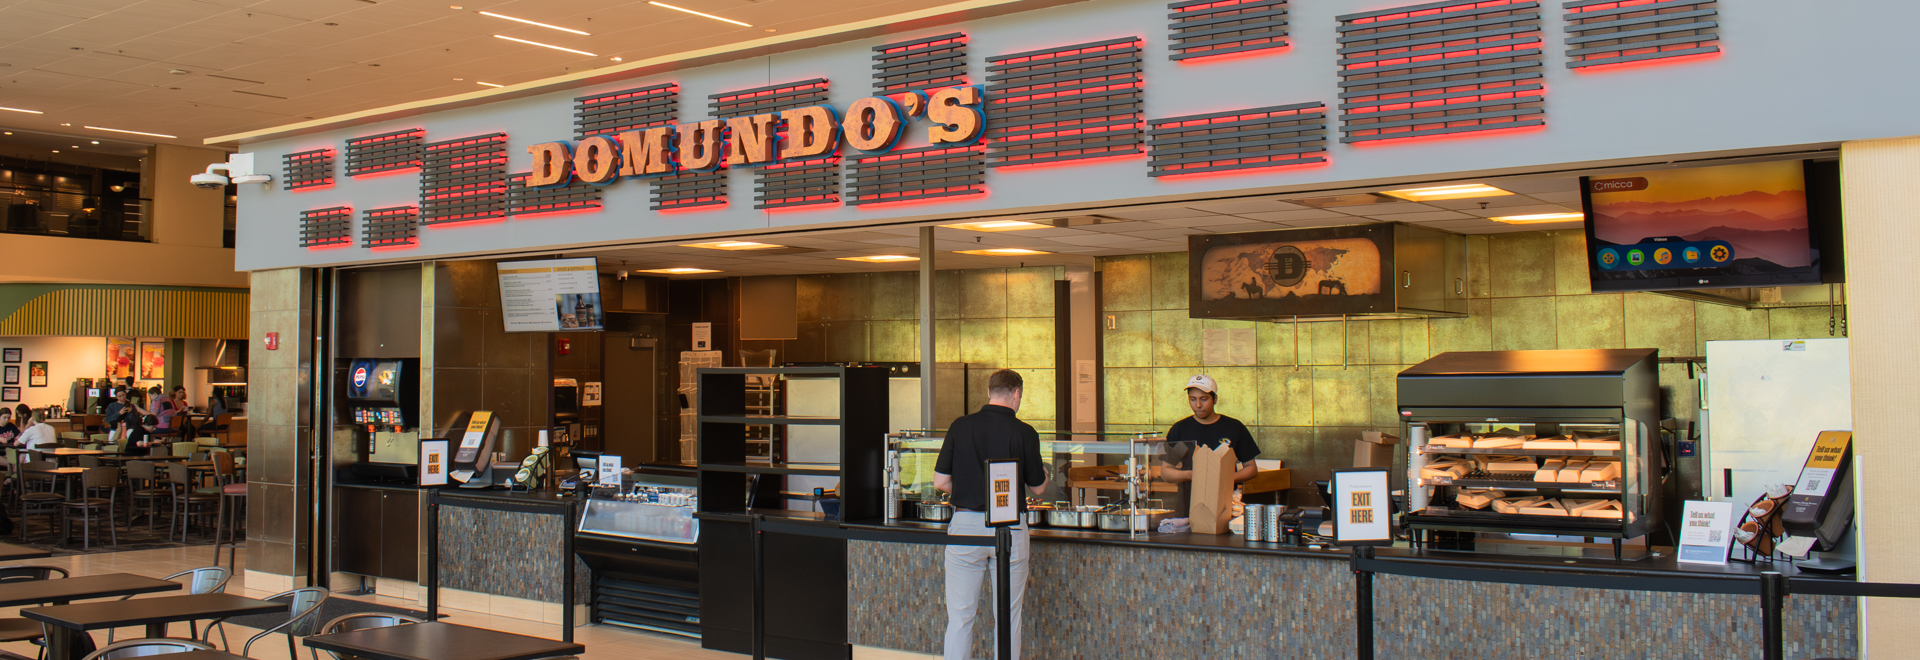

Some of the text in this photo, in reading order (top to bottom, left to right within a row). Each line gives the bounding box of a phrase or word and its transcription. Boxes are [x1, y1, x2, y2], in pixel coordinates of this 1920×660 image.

[526, 85, 985, 189] DOMUNDO'S
[1604, 180, 1632, 189] micca
[995, 480, 1010, 492] ENTER
[997, 495, 1008, 507] HERE
[1352, 493, 1370, 506] EXIT
[1352, 509, 1372, 523] HERE
